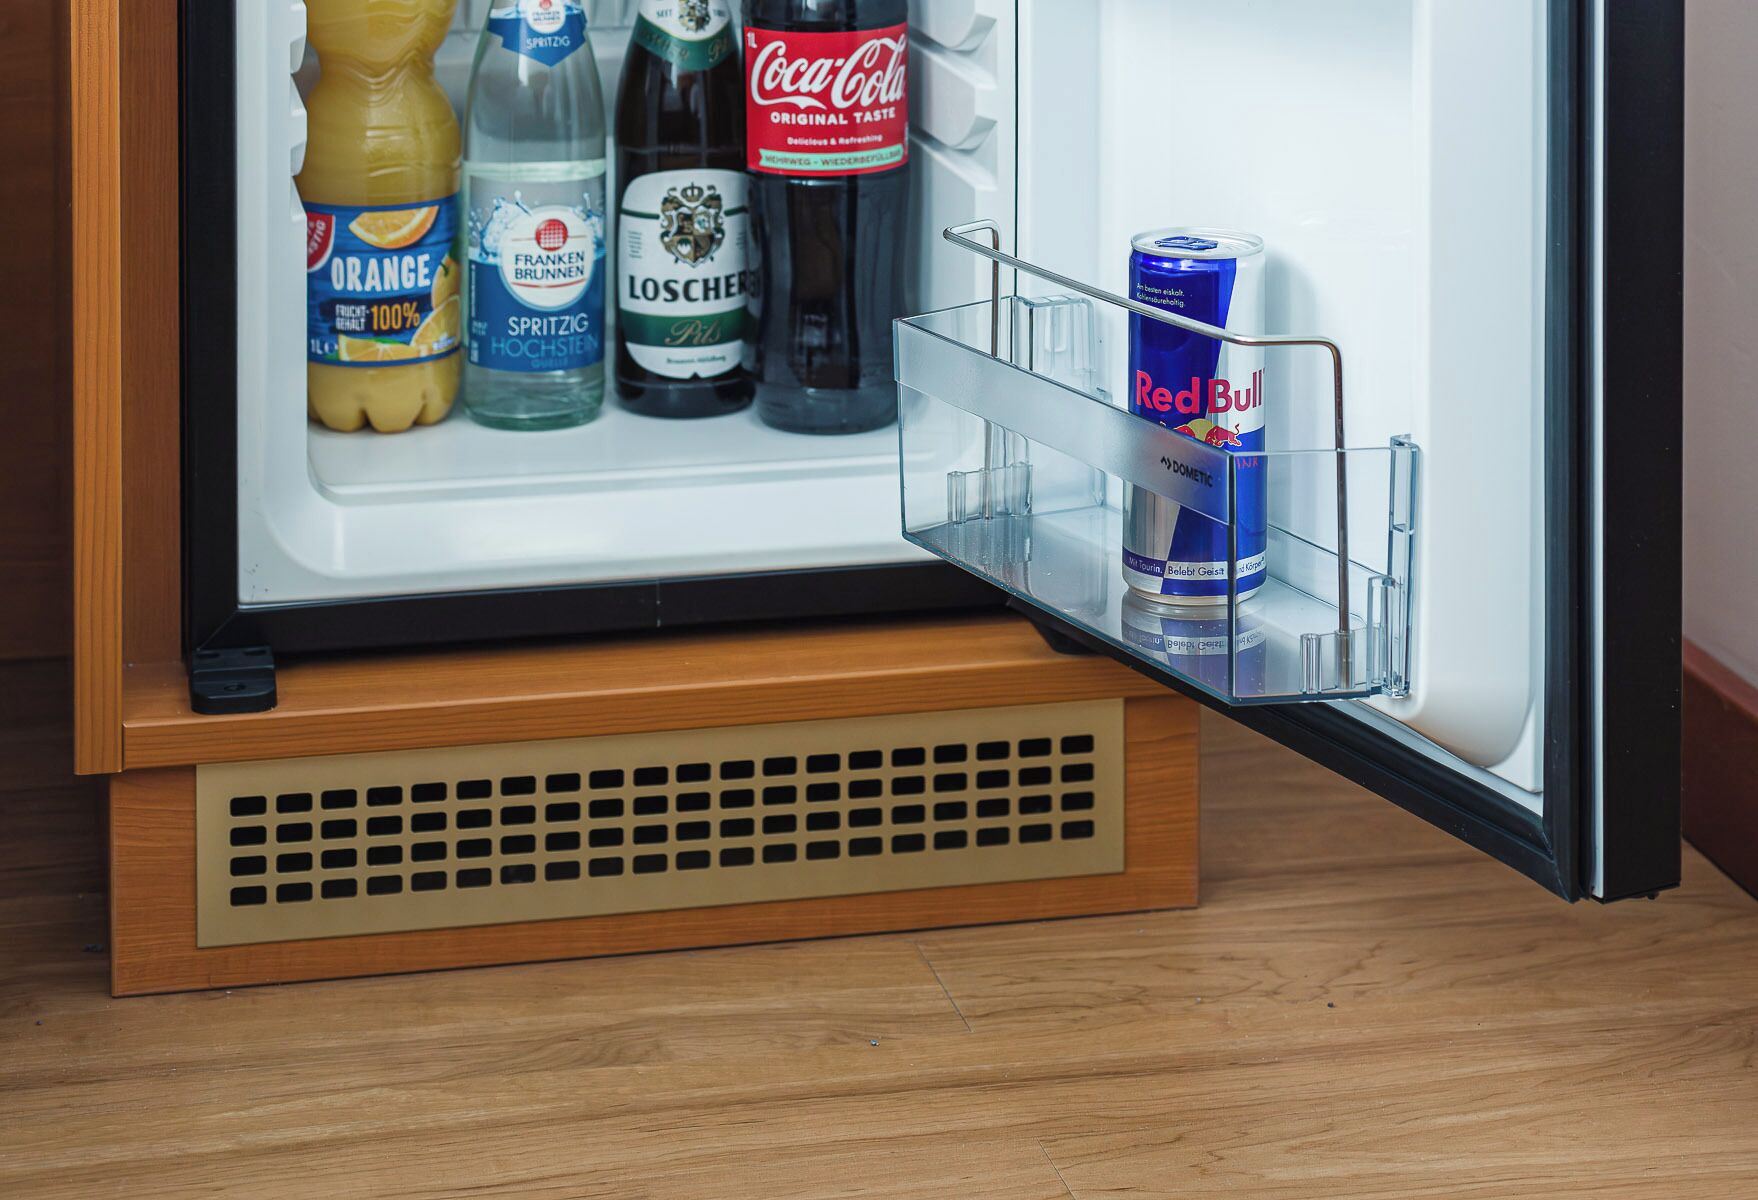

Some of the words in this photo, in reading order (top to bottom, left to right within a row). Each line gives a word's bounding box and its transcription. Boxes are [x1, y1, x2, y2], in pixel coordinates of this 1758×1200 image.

[526, 35, 571, 50] SPRITZIG
[751, 33, 906, 111] Coca-Cola
[770, 111, 849, 126] ORIGINAL
[853, 107, 897, 124] TASTE
[787, 136, 828, 146] Delicious
[830, 137, 837, 146] &
[839, 134, 883, 146] Refreshing
[765, 155, 812, 166] MEHRWEG
[514, 251, 585, 267] FRANKEN
[330, 253, 432, 293] ORANGE
[514, 265, 585, 281] BRUNNEN
[1144, 284, 1162, 295] besten
[335, 303, 370, 317] FRUCHT-
[371, 301, 421, 331] 100%
[335, 317, 367, 332] GEHALT
[507, 312, 589, 337] SPRITZIG
[664, 319, 721, 346] Pils
[1136, 369, 1200, 414] Red
[1207, 369, 1262, 414] Bull
[1172, 460, 1214, 488] DOMETIC
[1129, 556, 1138, 568] Mit
[1138, 559, 1164, 574] Taurin.
[1168, 565, 1195, 576] Belebt
